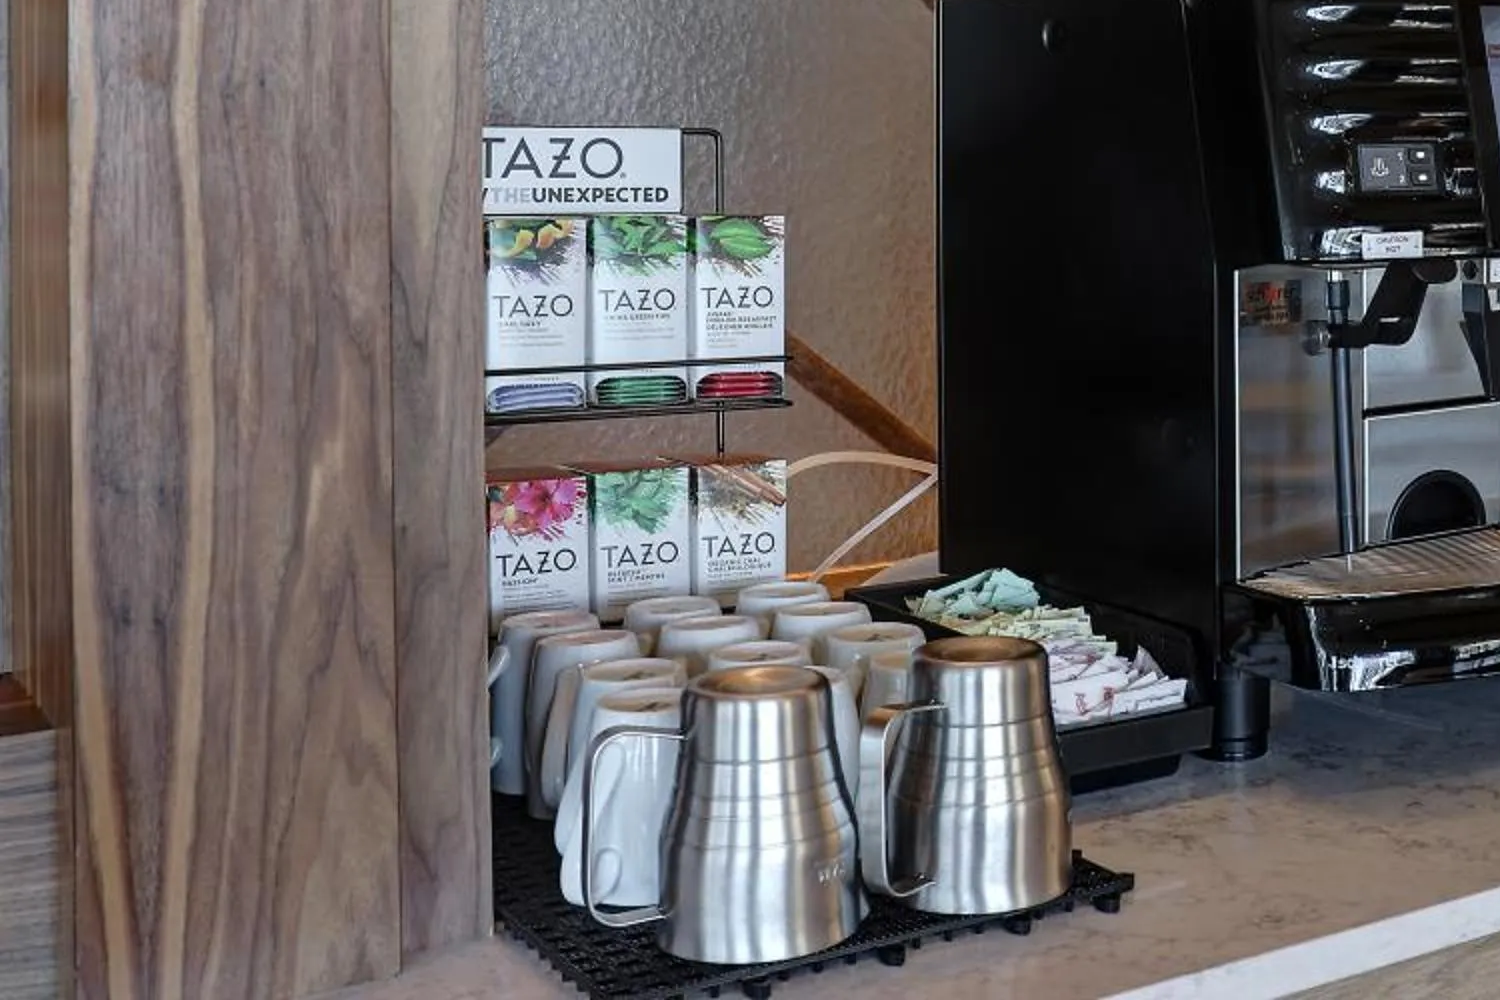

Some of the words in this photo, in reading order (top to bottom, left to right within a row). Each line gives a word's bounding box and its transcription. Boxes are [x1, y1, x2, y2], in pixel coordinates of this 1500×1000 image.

[482, 136, 624, 179] TAZO
[492, 293, 574, 318] TAZO
[599, 288, 676, 312] TAZO
[700, 285, 774, 308] TAZO
[600, 541, 679, 568] TAZO
[701, 531, 775, 557] TAZO
[496, 548, 577, 577] TAZO
